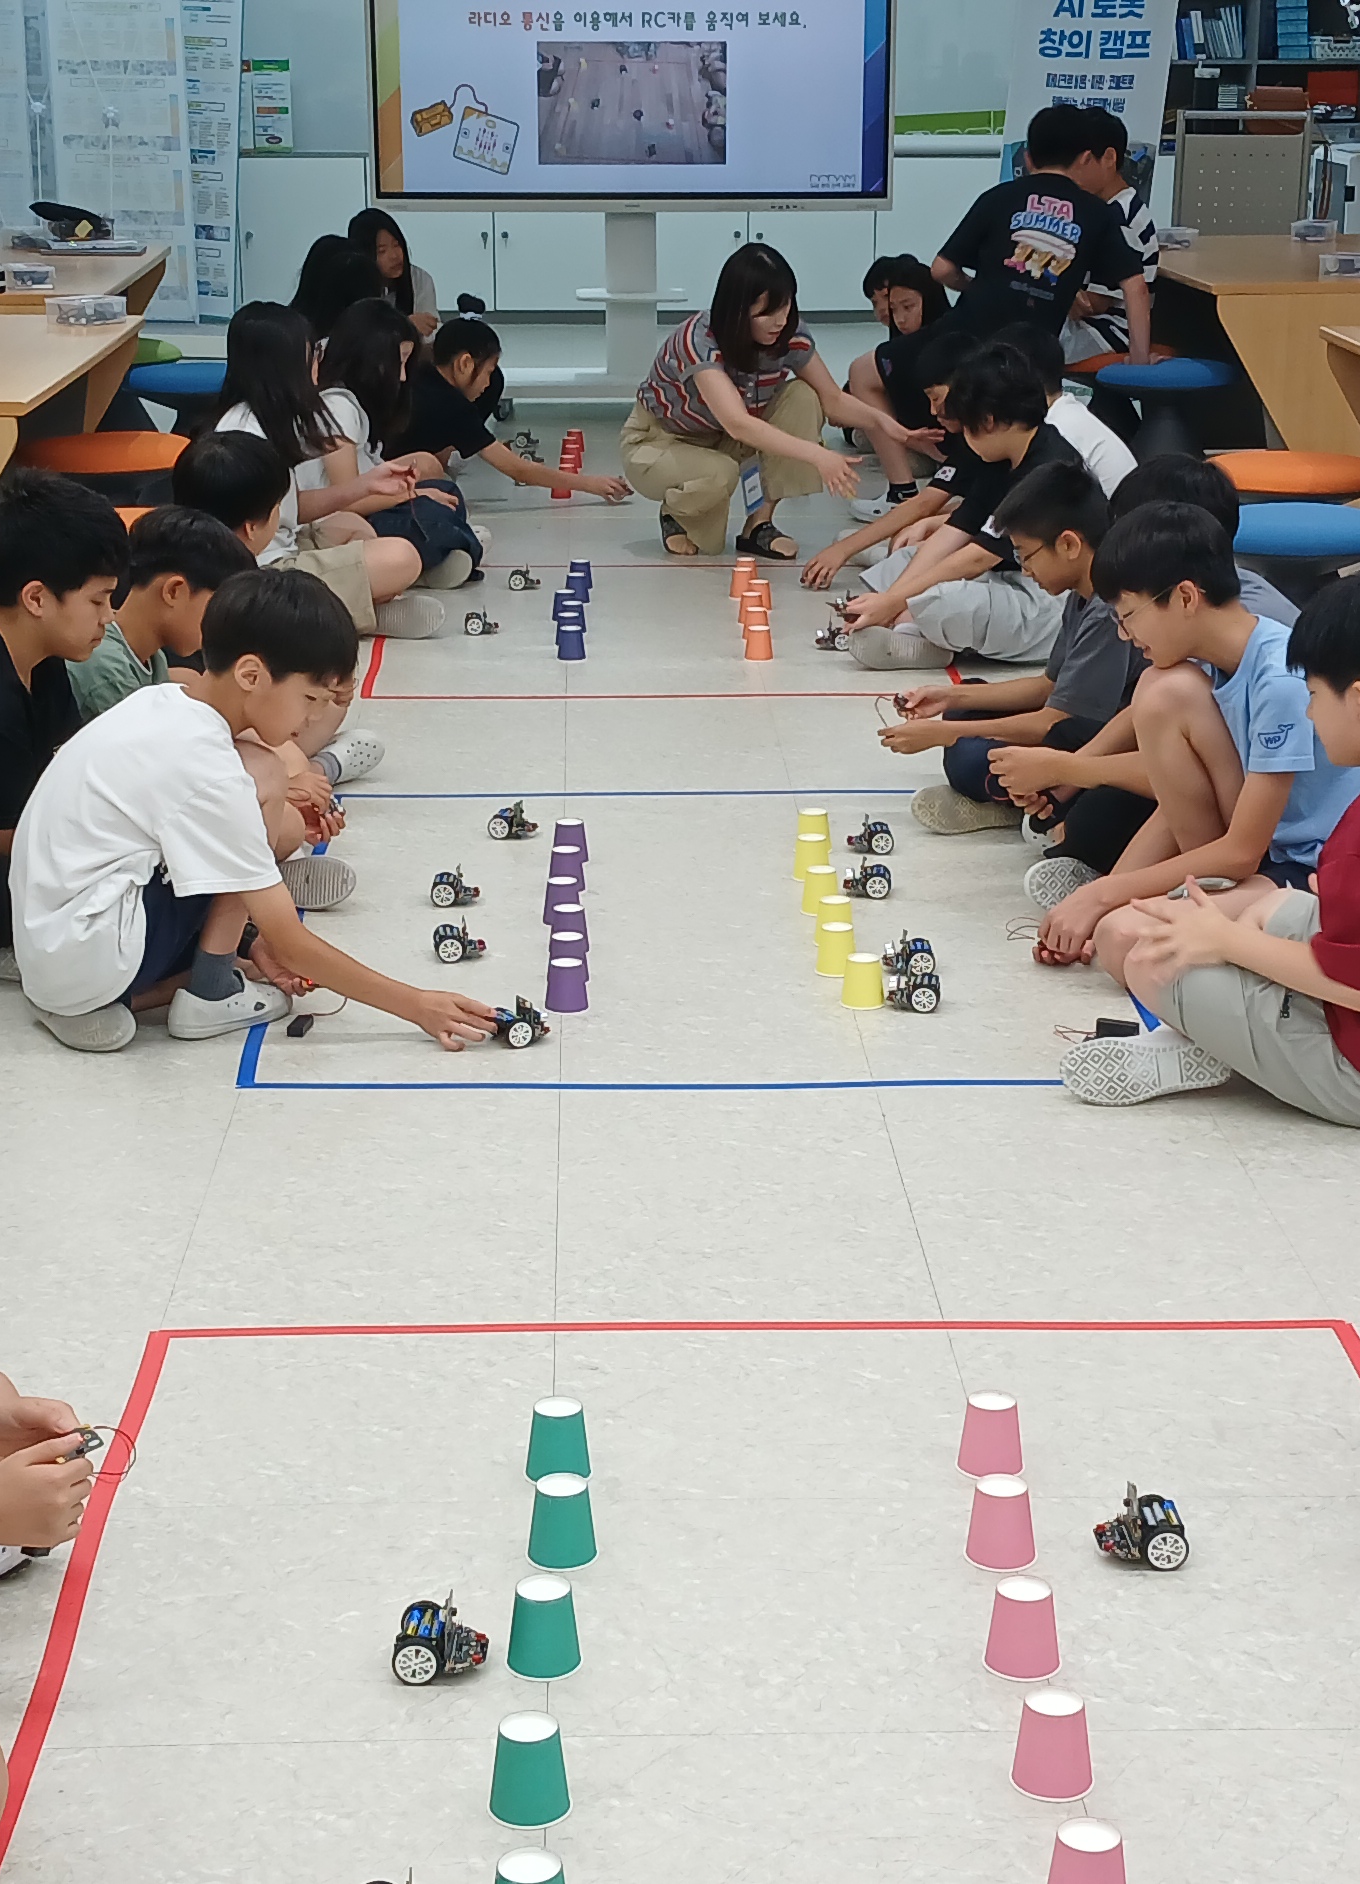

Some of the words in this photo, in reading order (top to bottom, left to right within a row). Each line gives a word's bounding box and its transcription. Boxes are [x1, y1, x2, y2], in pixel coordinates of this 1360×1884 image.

[468, 11, 512, 27] 라디오
[521, 10, 565, 31] 통신을
[574, 10, 633, 31] 이용해서
[641, 10, 696, 31] RC카를
[705, 11, 749, 31] 움직여
[758, 11, 807, 29] 보세요.
[1053, 0, 1084, 18] AI
[1038, 28, 1092, 59] 창의
[1099, 30, 1151, 59] 캠프
[1027, 194, 1073, 221] LTA
[1010, 211, 1081, 243] SUMMER
